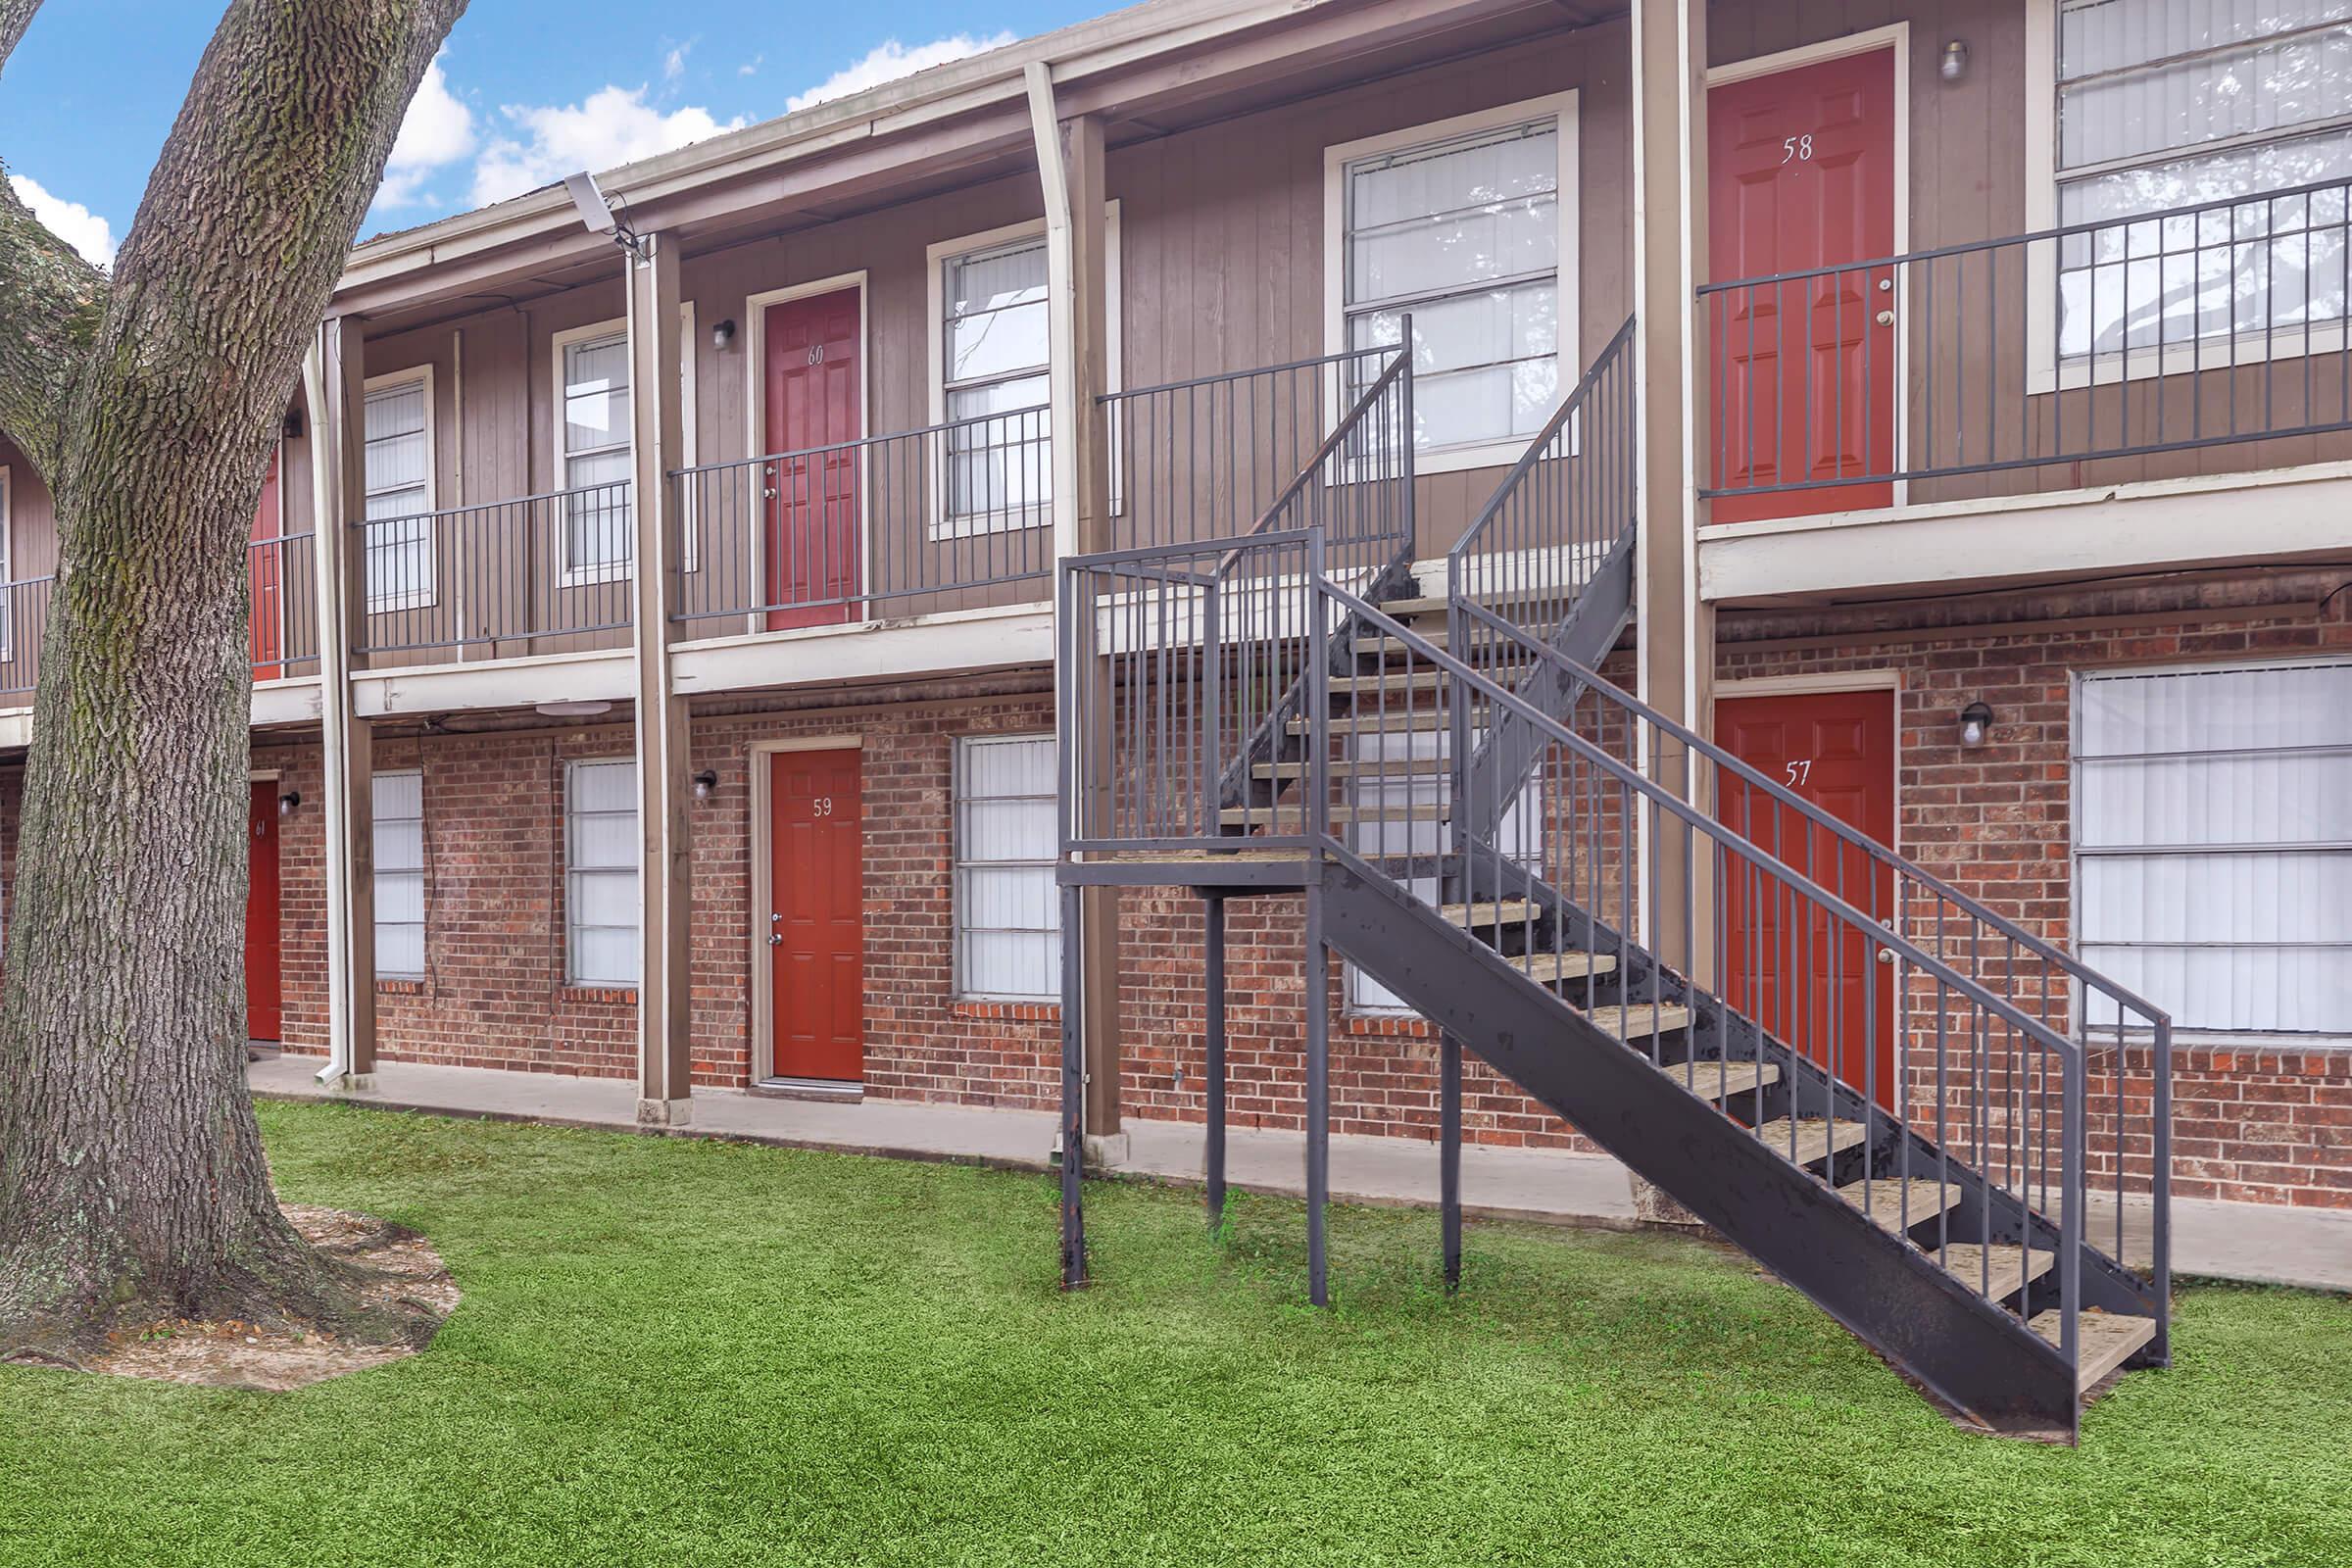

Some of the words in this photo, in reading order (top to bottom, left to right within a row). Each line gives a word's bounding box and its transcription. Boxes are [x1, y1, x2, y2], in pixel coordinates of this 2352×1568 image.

[1782, 134, 1812, 164] 58
[808, 345, 823, 366] 60
[1786, 760, 1811, 787] 57
[813, 798, 832, 816] 59
